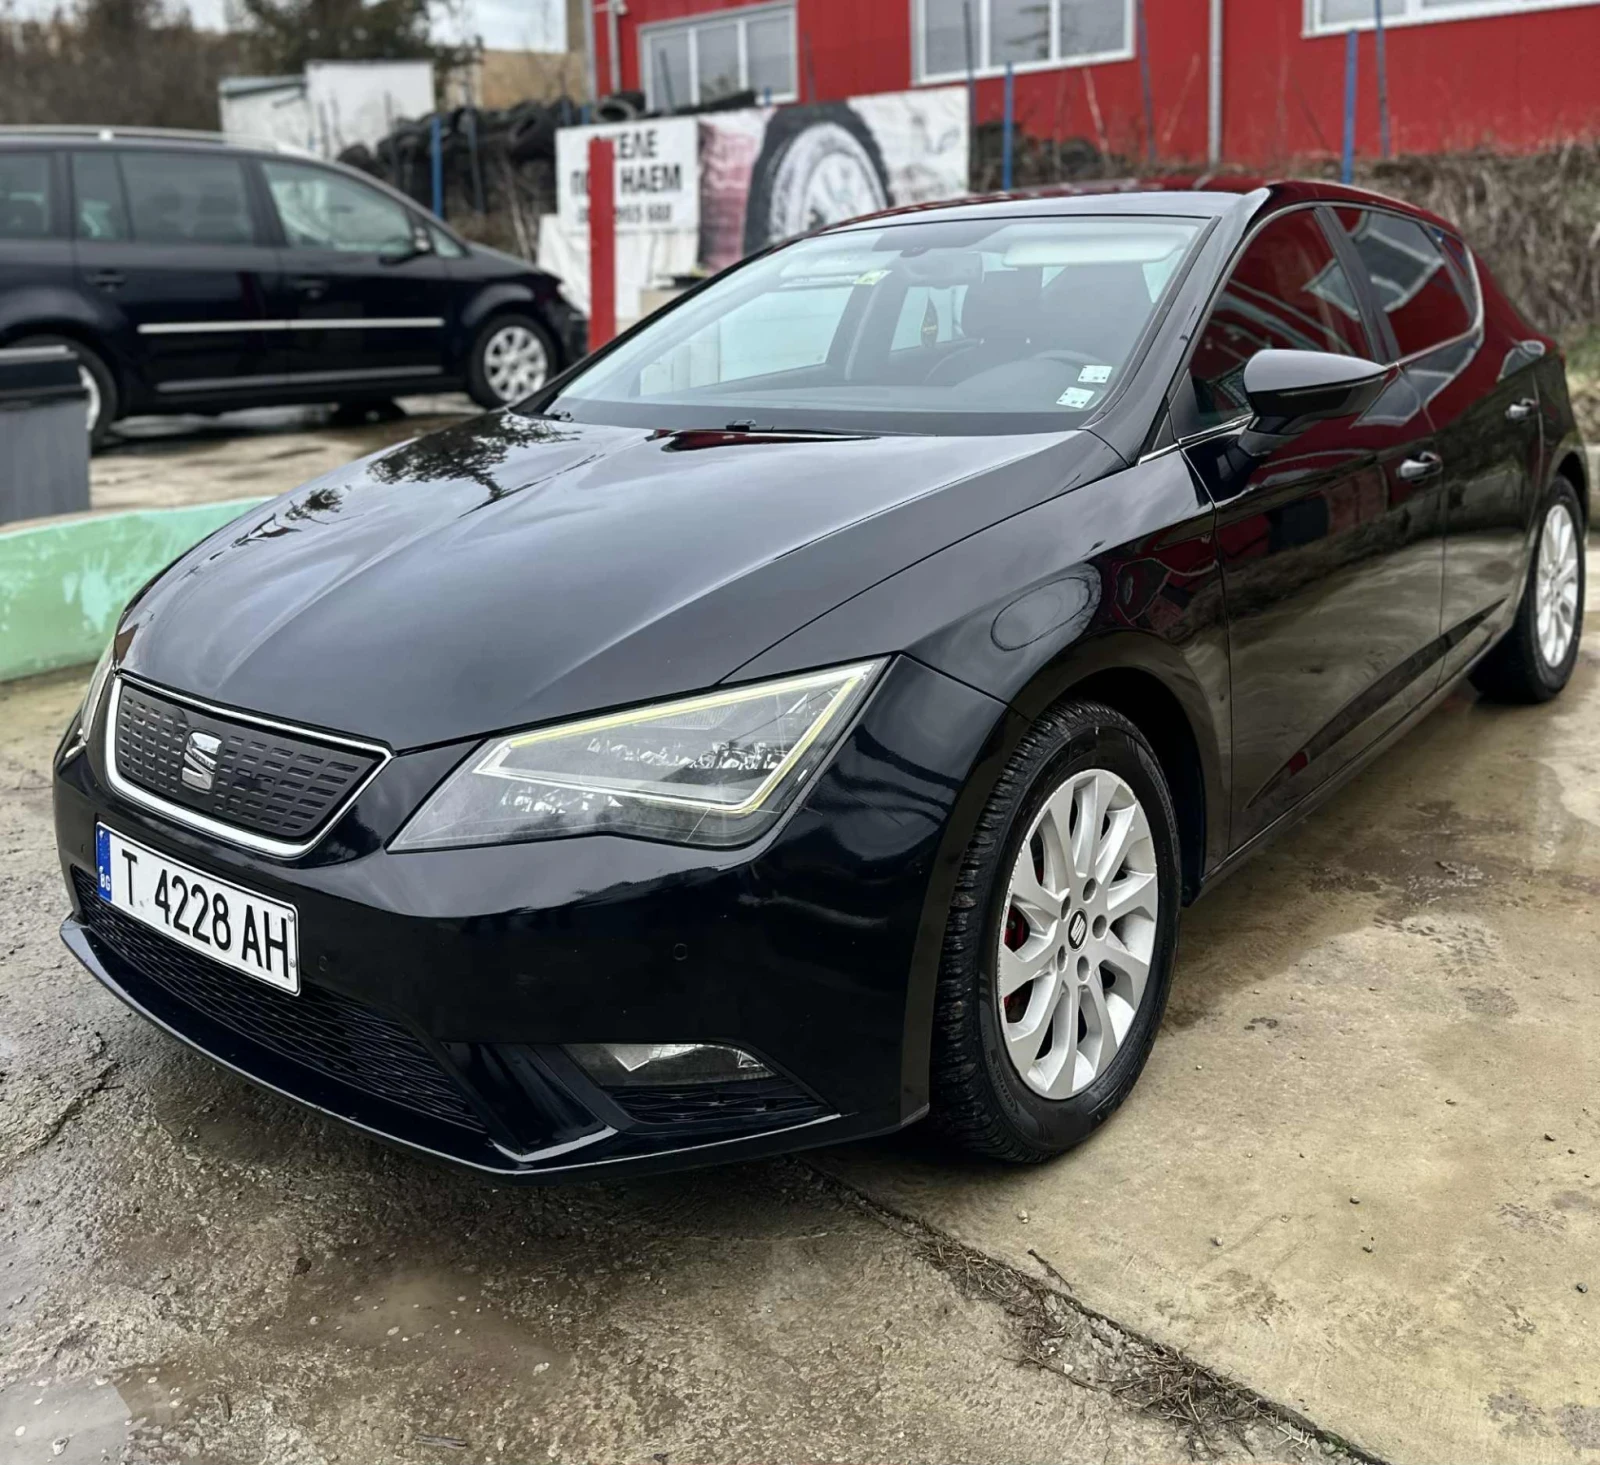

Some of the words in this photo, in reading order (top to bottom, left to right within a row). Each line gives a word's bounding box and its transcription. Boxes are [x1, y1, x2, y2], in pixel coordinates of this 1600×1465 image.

[620, 164, 682, 196] НАЕМ
[100, 873, 111, 891] BG
[121, 848, 138, 907] T
[154, 868, 232, 952] 4228
[241, 904, 291, 980] AH
